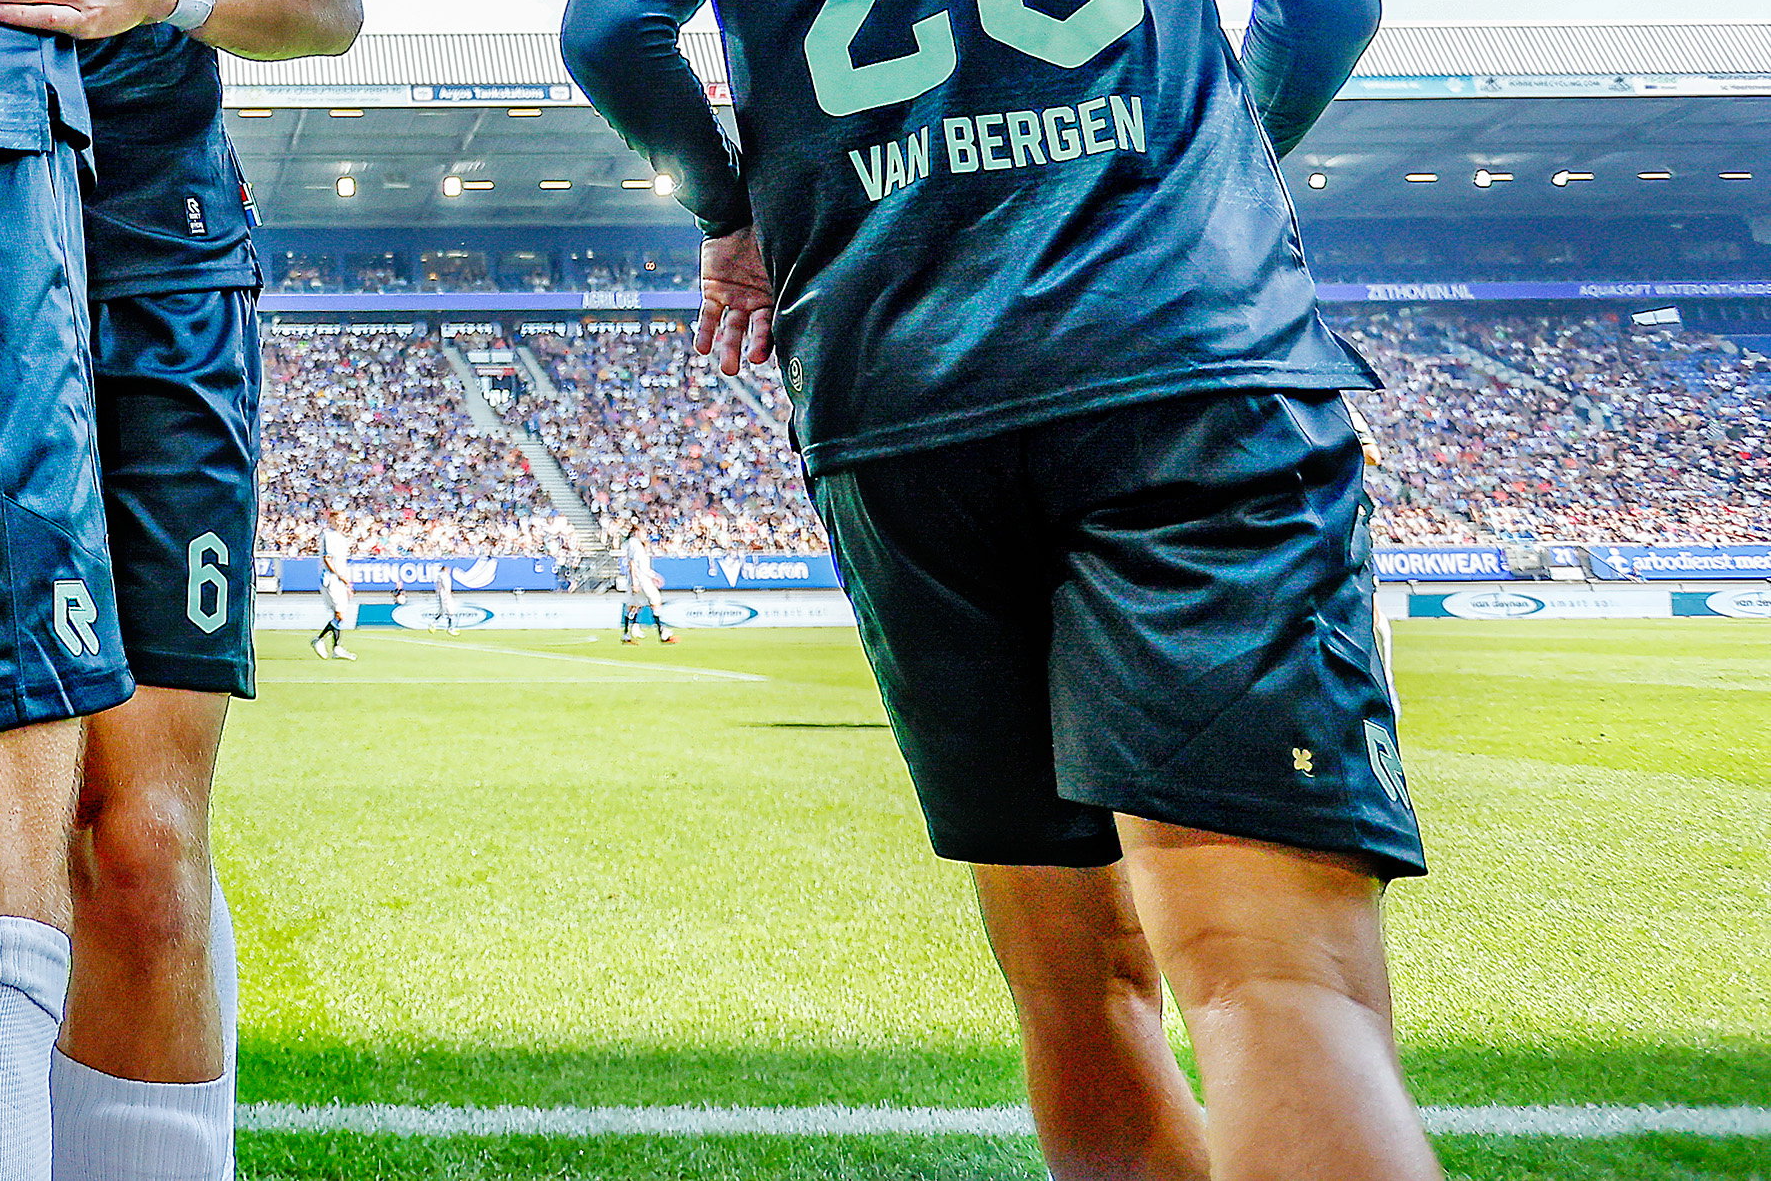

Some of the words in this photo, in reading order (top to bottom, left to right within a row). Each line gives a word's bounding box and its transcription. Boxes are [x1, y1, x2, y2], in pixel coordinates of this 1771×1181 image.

[848, 126, 930, 202] VAN
[942, 94, 1147, 175] BERGEN
[186, 530, 229, 634] 6
[743, 560, 809, 581] macron
[1373, 552, 1501, 575] WORKWEAR
